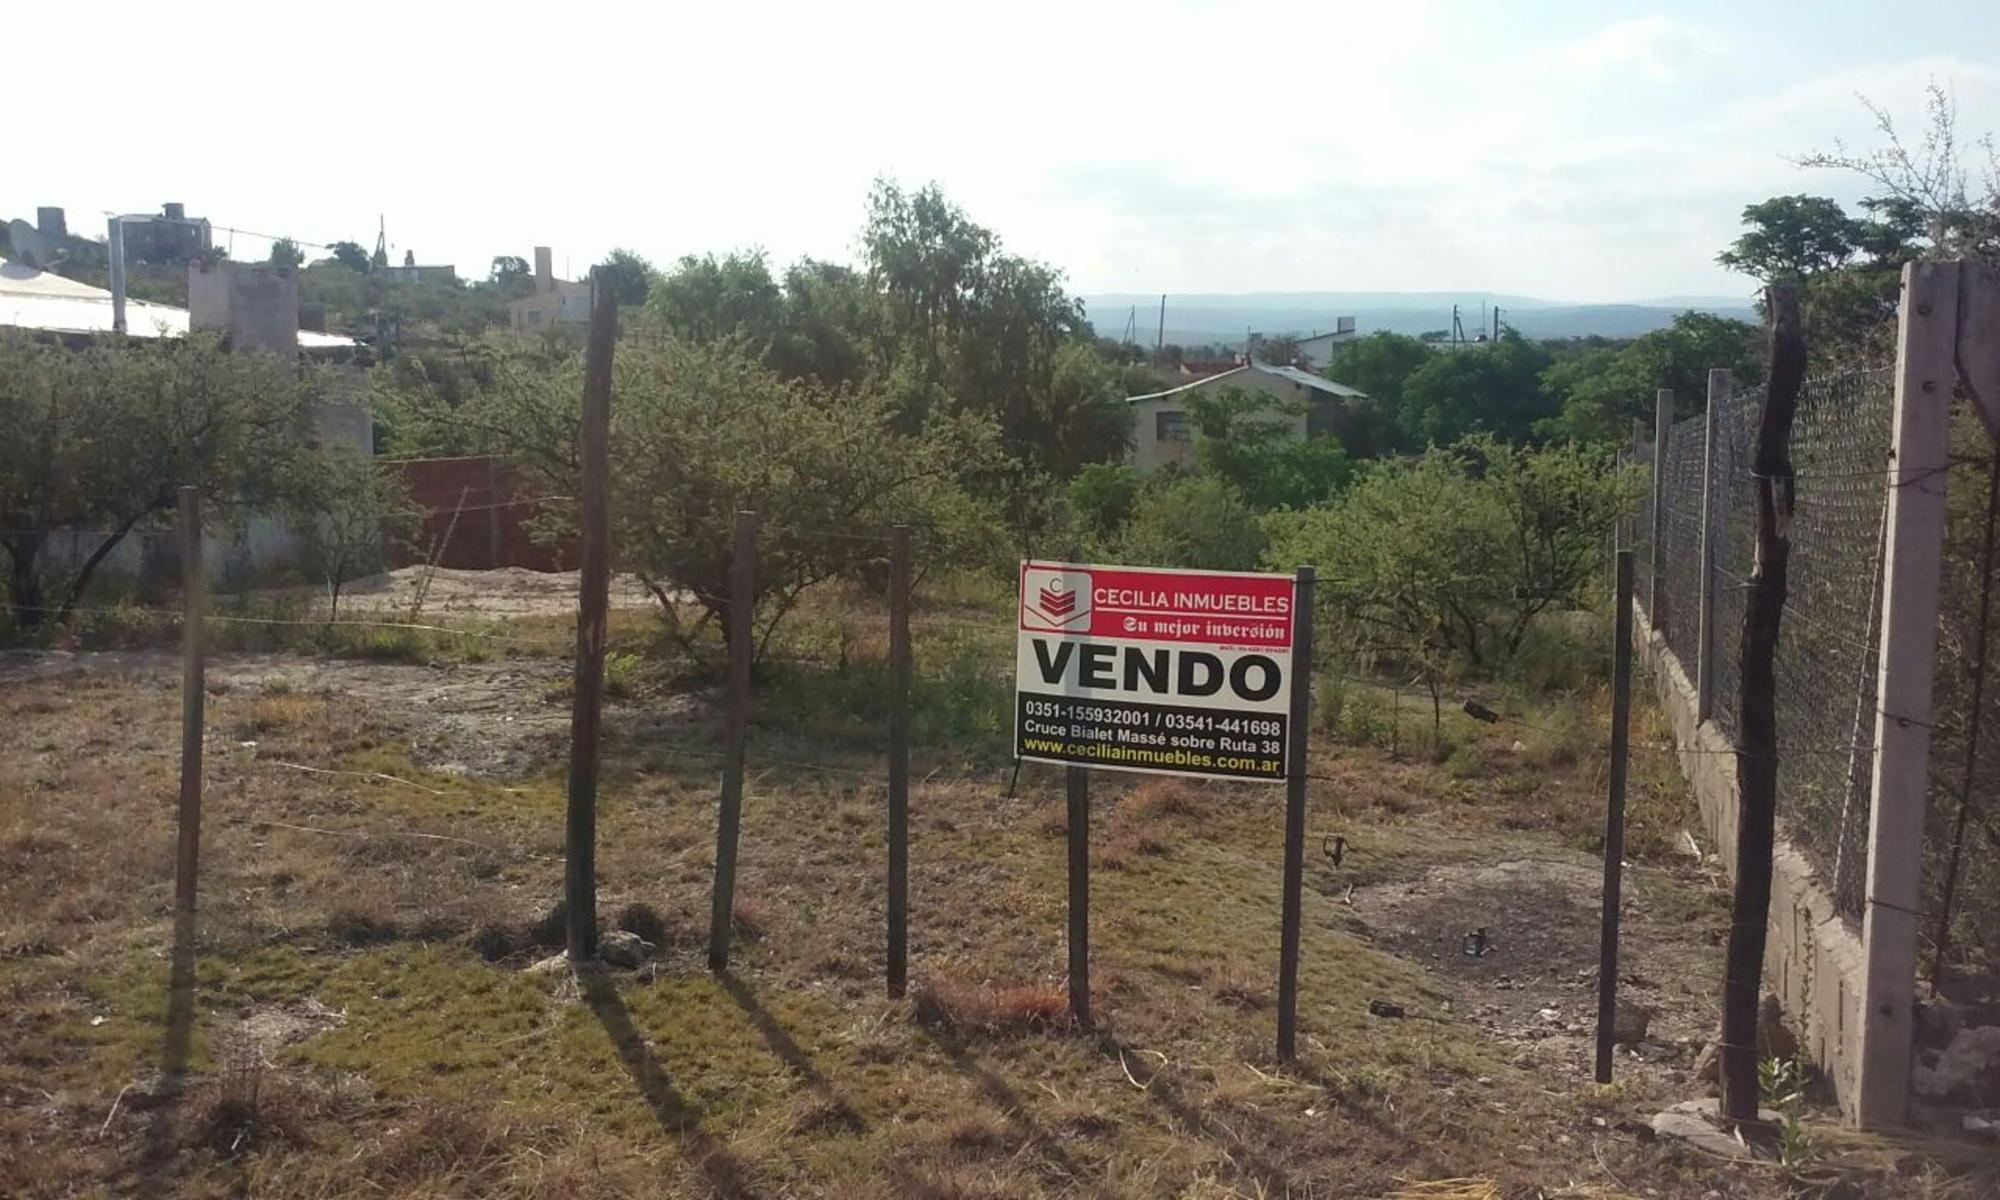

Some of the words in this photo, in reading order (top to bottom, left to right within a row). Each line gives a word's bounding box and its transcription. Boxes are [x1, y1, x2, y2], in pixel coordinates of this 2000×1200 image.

[1094, 588, 1169, 607] CECILIA
[1174, 593, 1288, 613] INMUEBLES
[1154, 620, 1200, 637] mejor
[1207, 621, 1285, 639] inversión
[1032, 639, 1281, 702] VENDO
[1026, 701, 1150, 726] 0351-155932001
[1156, 714, 1161, 727] /
[1165, 714, 1280, 736] 03541-441698
[1025, 720, 1066, 737] Cruce
[1071, 724, 1113, 741] Bialet
[1118, 729, 1165, 745] Massé
[1170, 733, 1215, 749] sobre
[1220, 738, 1257, 753] Ruta
[1261, 741, 1280, 754] 38
[1024, 738, 1280, 772] www.ceciliainmuebles.com.ar
